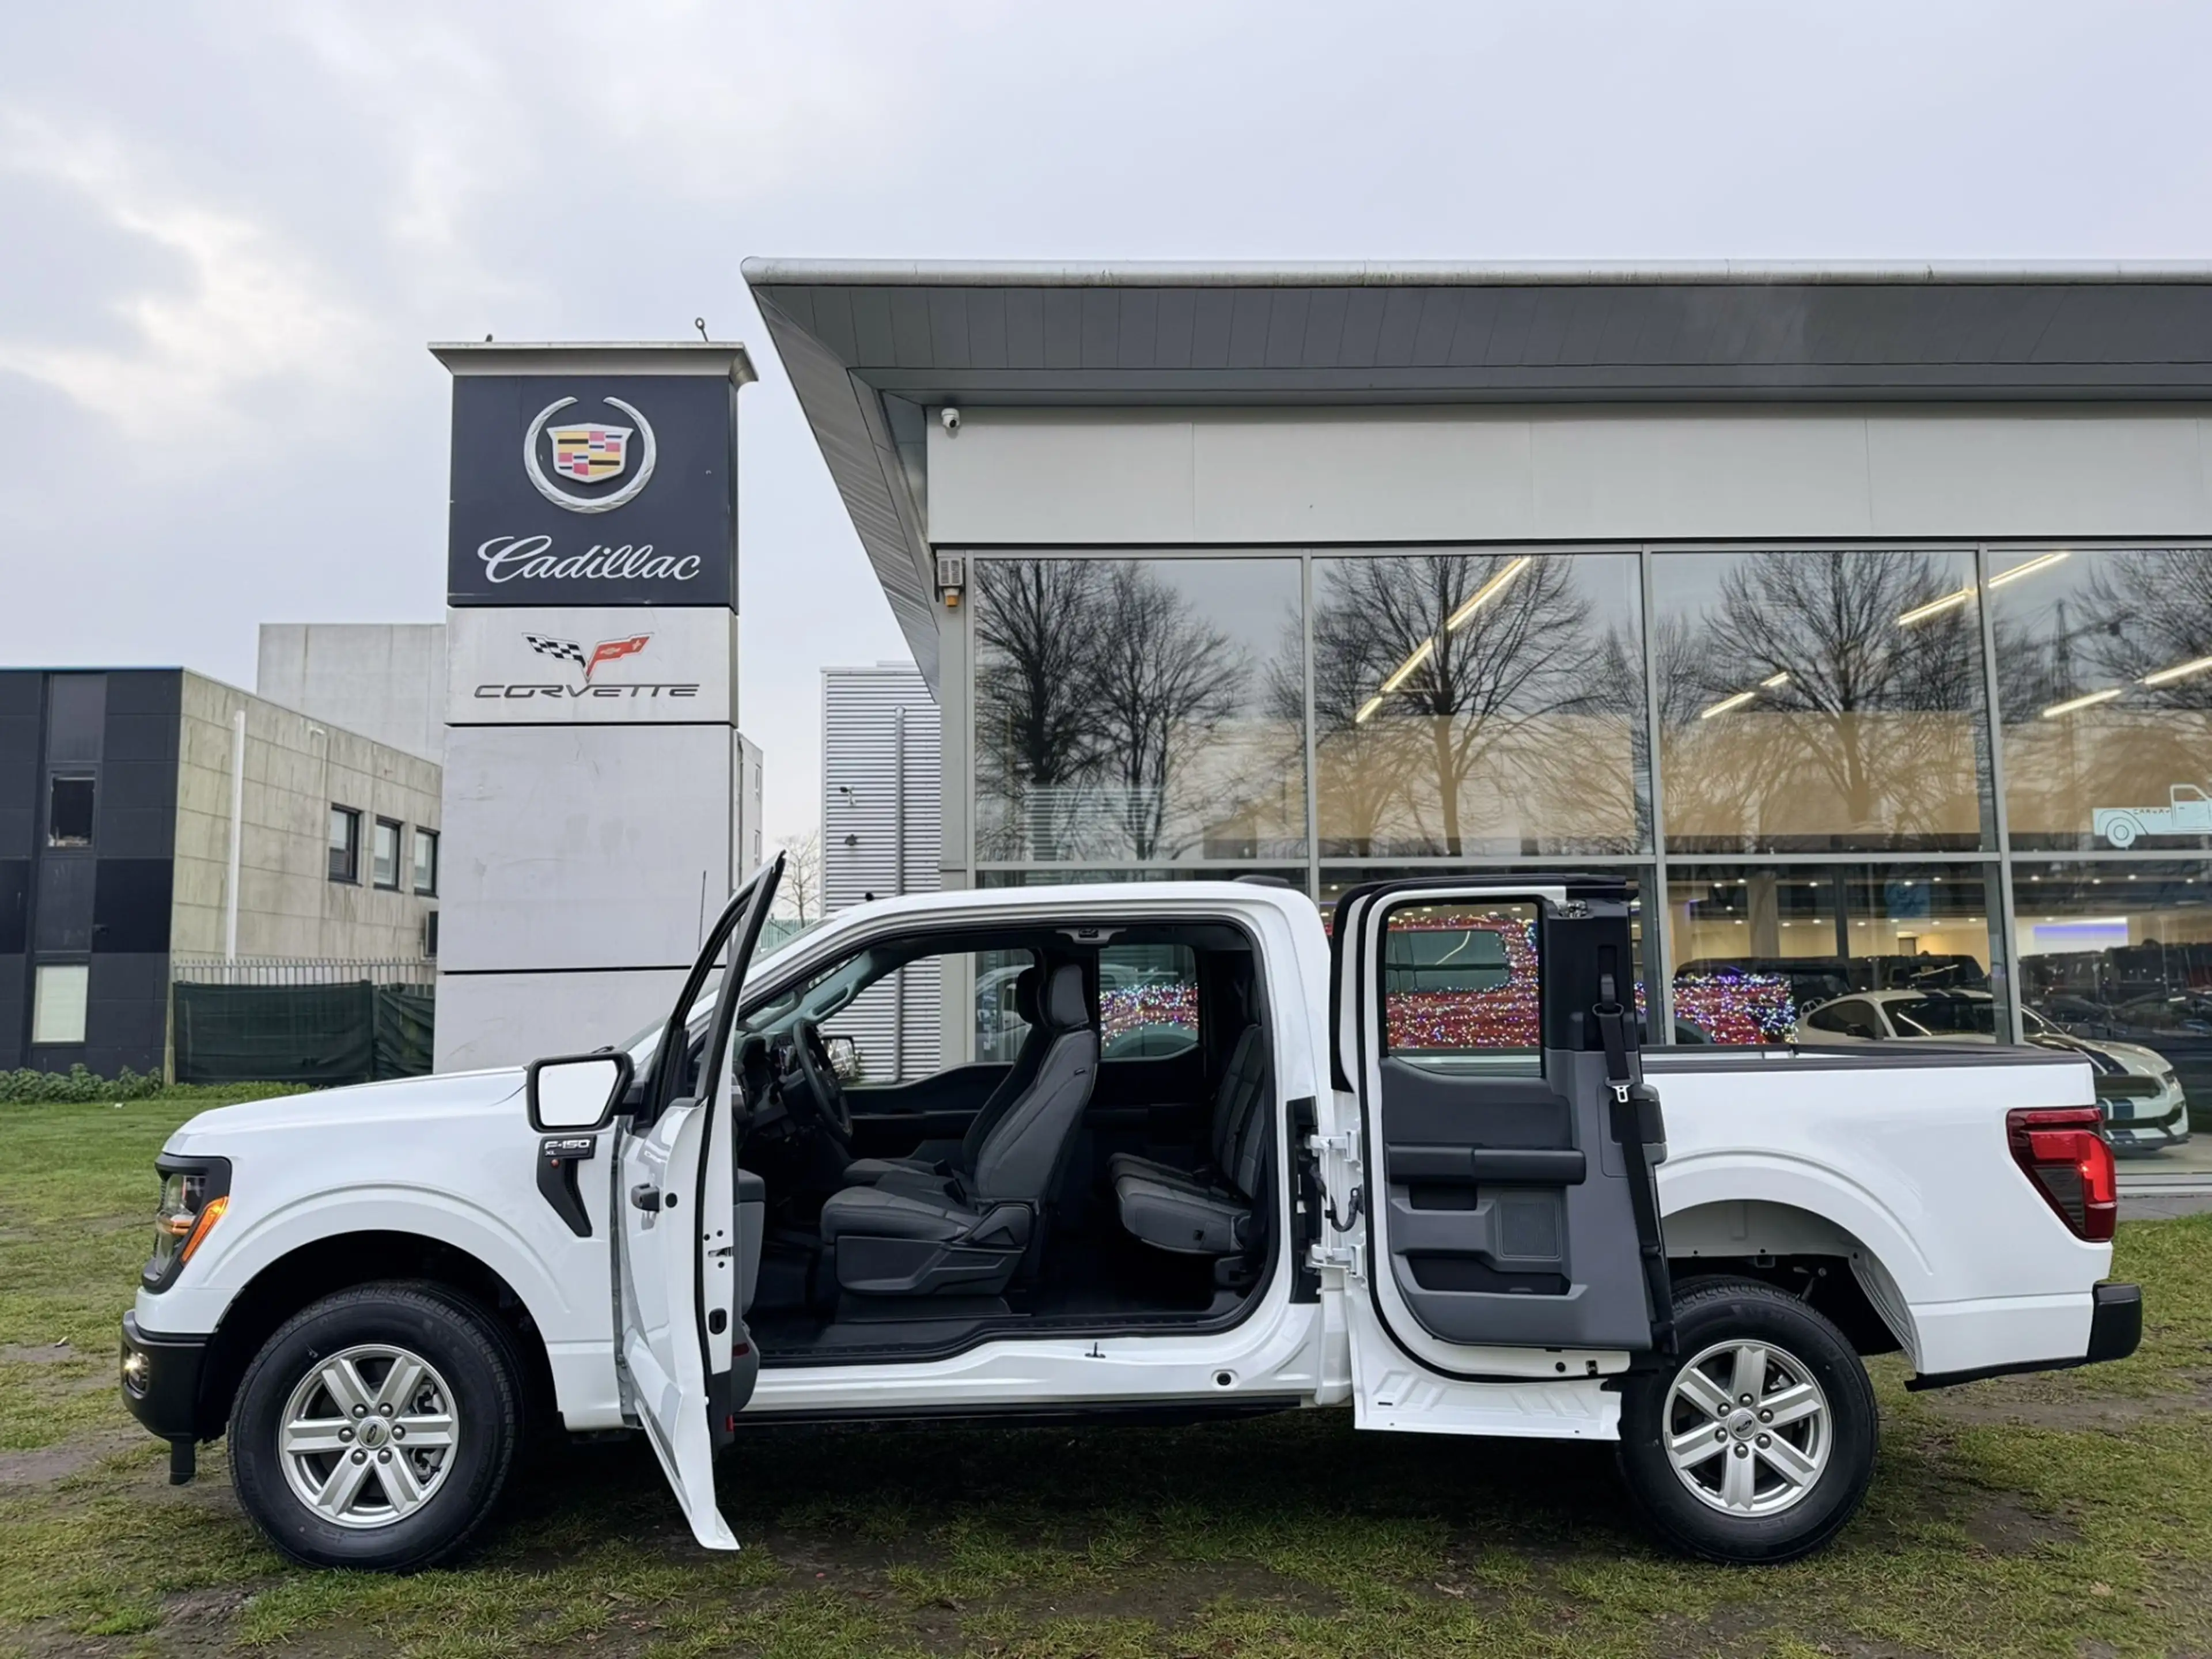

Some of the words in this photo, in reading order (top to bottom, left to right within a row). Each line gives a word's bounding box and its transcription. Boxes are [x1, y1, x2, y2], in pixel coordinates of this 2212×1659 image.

[478, 535, 700, 583] Cadillac
[474, 684, 699, 698] CORVETTE
[544, 1139, 590, 1149] F-150
